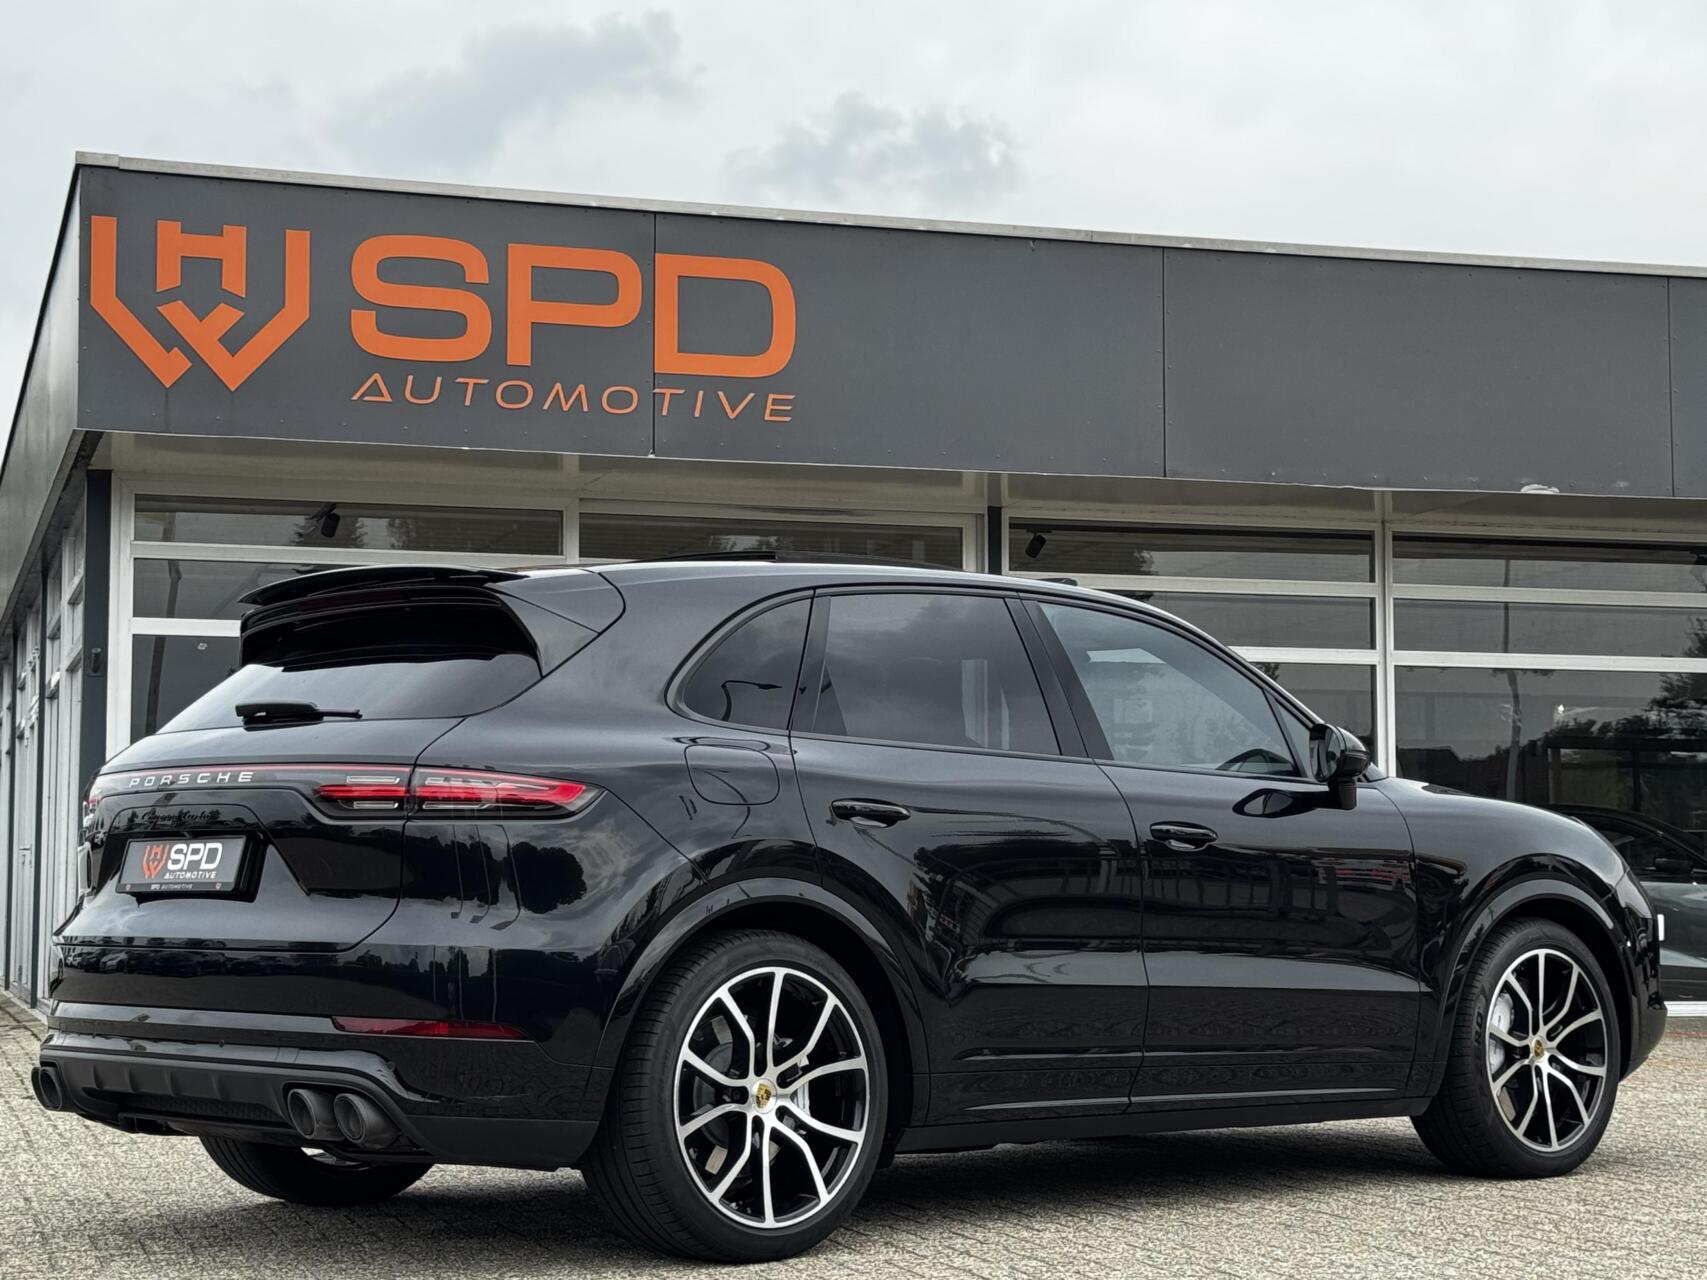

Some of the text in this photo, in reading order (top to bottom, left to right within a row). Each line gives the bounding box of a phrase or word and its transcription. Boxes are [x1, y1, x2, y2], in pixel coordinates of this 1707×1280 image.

[351, 235, 797, 378] SPD
[351, 372, 796, 421] AUTOMOTIVE
[128, 771, 254, 788] PORSCHE
[167, 843, 223, 870] SPD
[164, 871, 217, 880] AUTOMOTIVE
